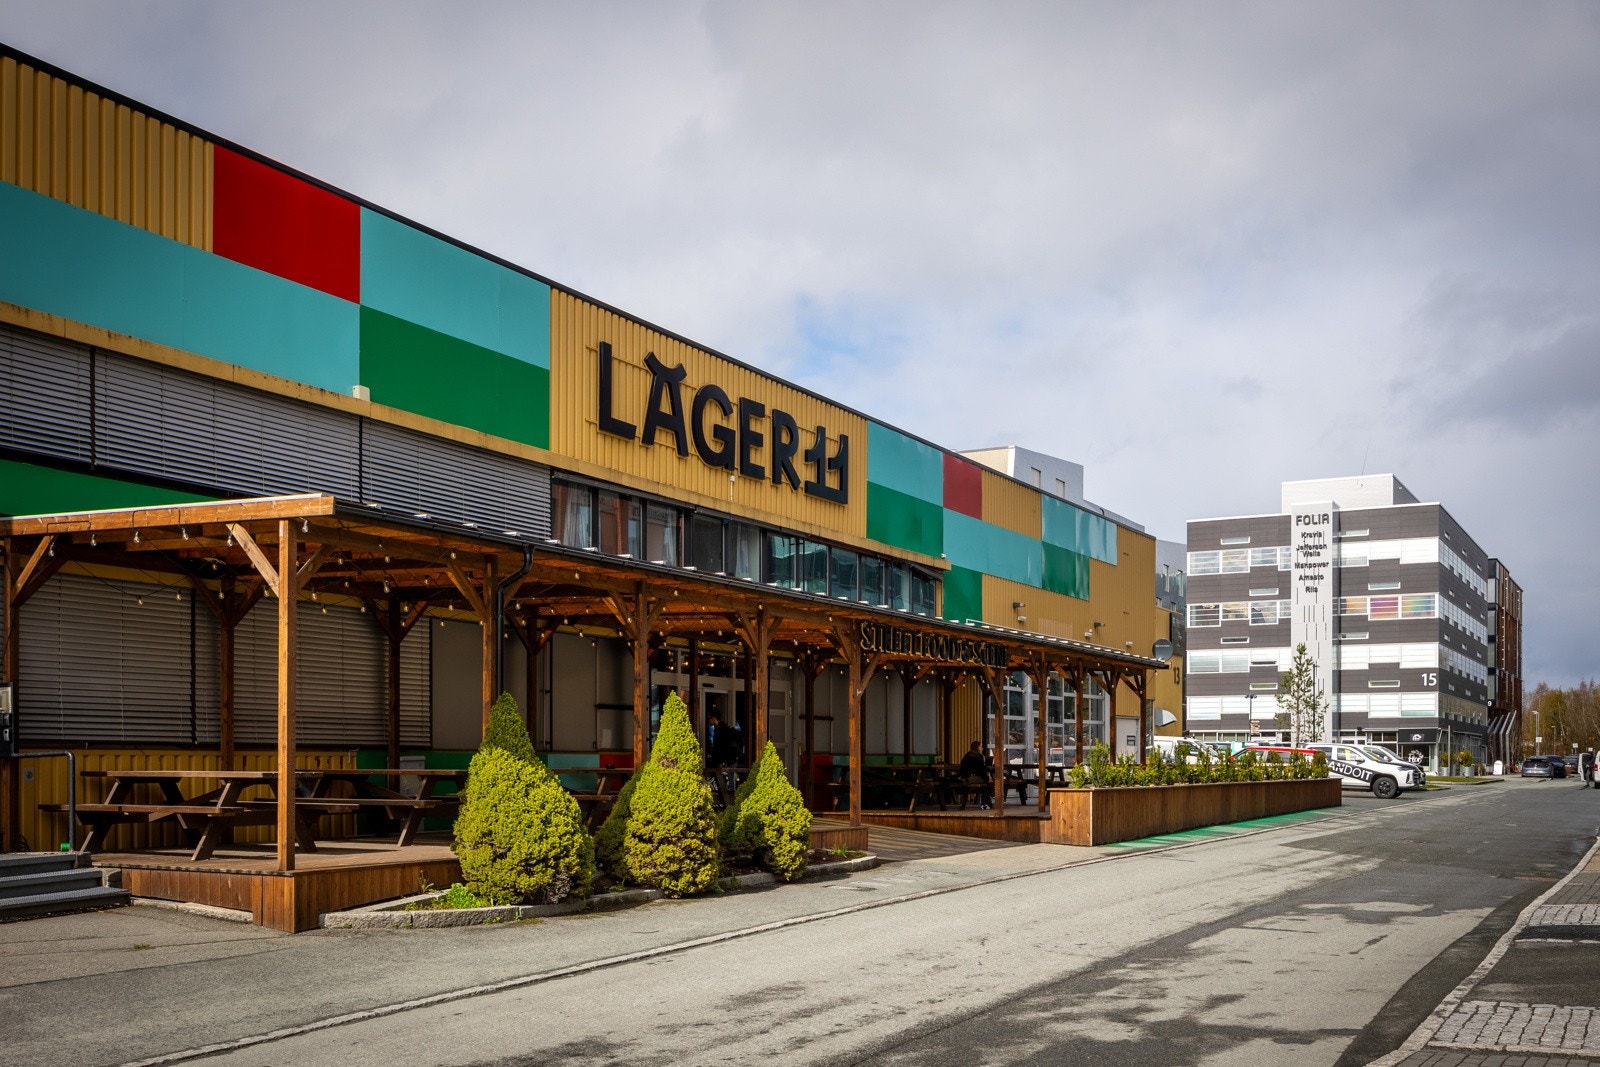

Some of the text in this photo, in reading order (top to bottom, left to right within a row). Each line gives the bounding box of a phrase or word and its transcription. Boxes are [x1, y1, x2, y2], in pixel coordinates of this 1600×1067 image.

[1296, 513, 1330, 526] FOLIA
[1295, 562, 1329, 570] Manpower
[1173, 667, 1180, 685] 13
[1421, 673, 1437, 686] 15
